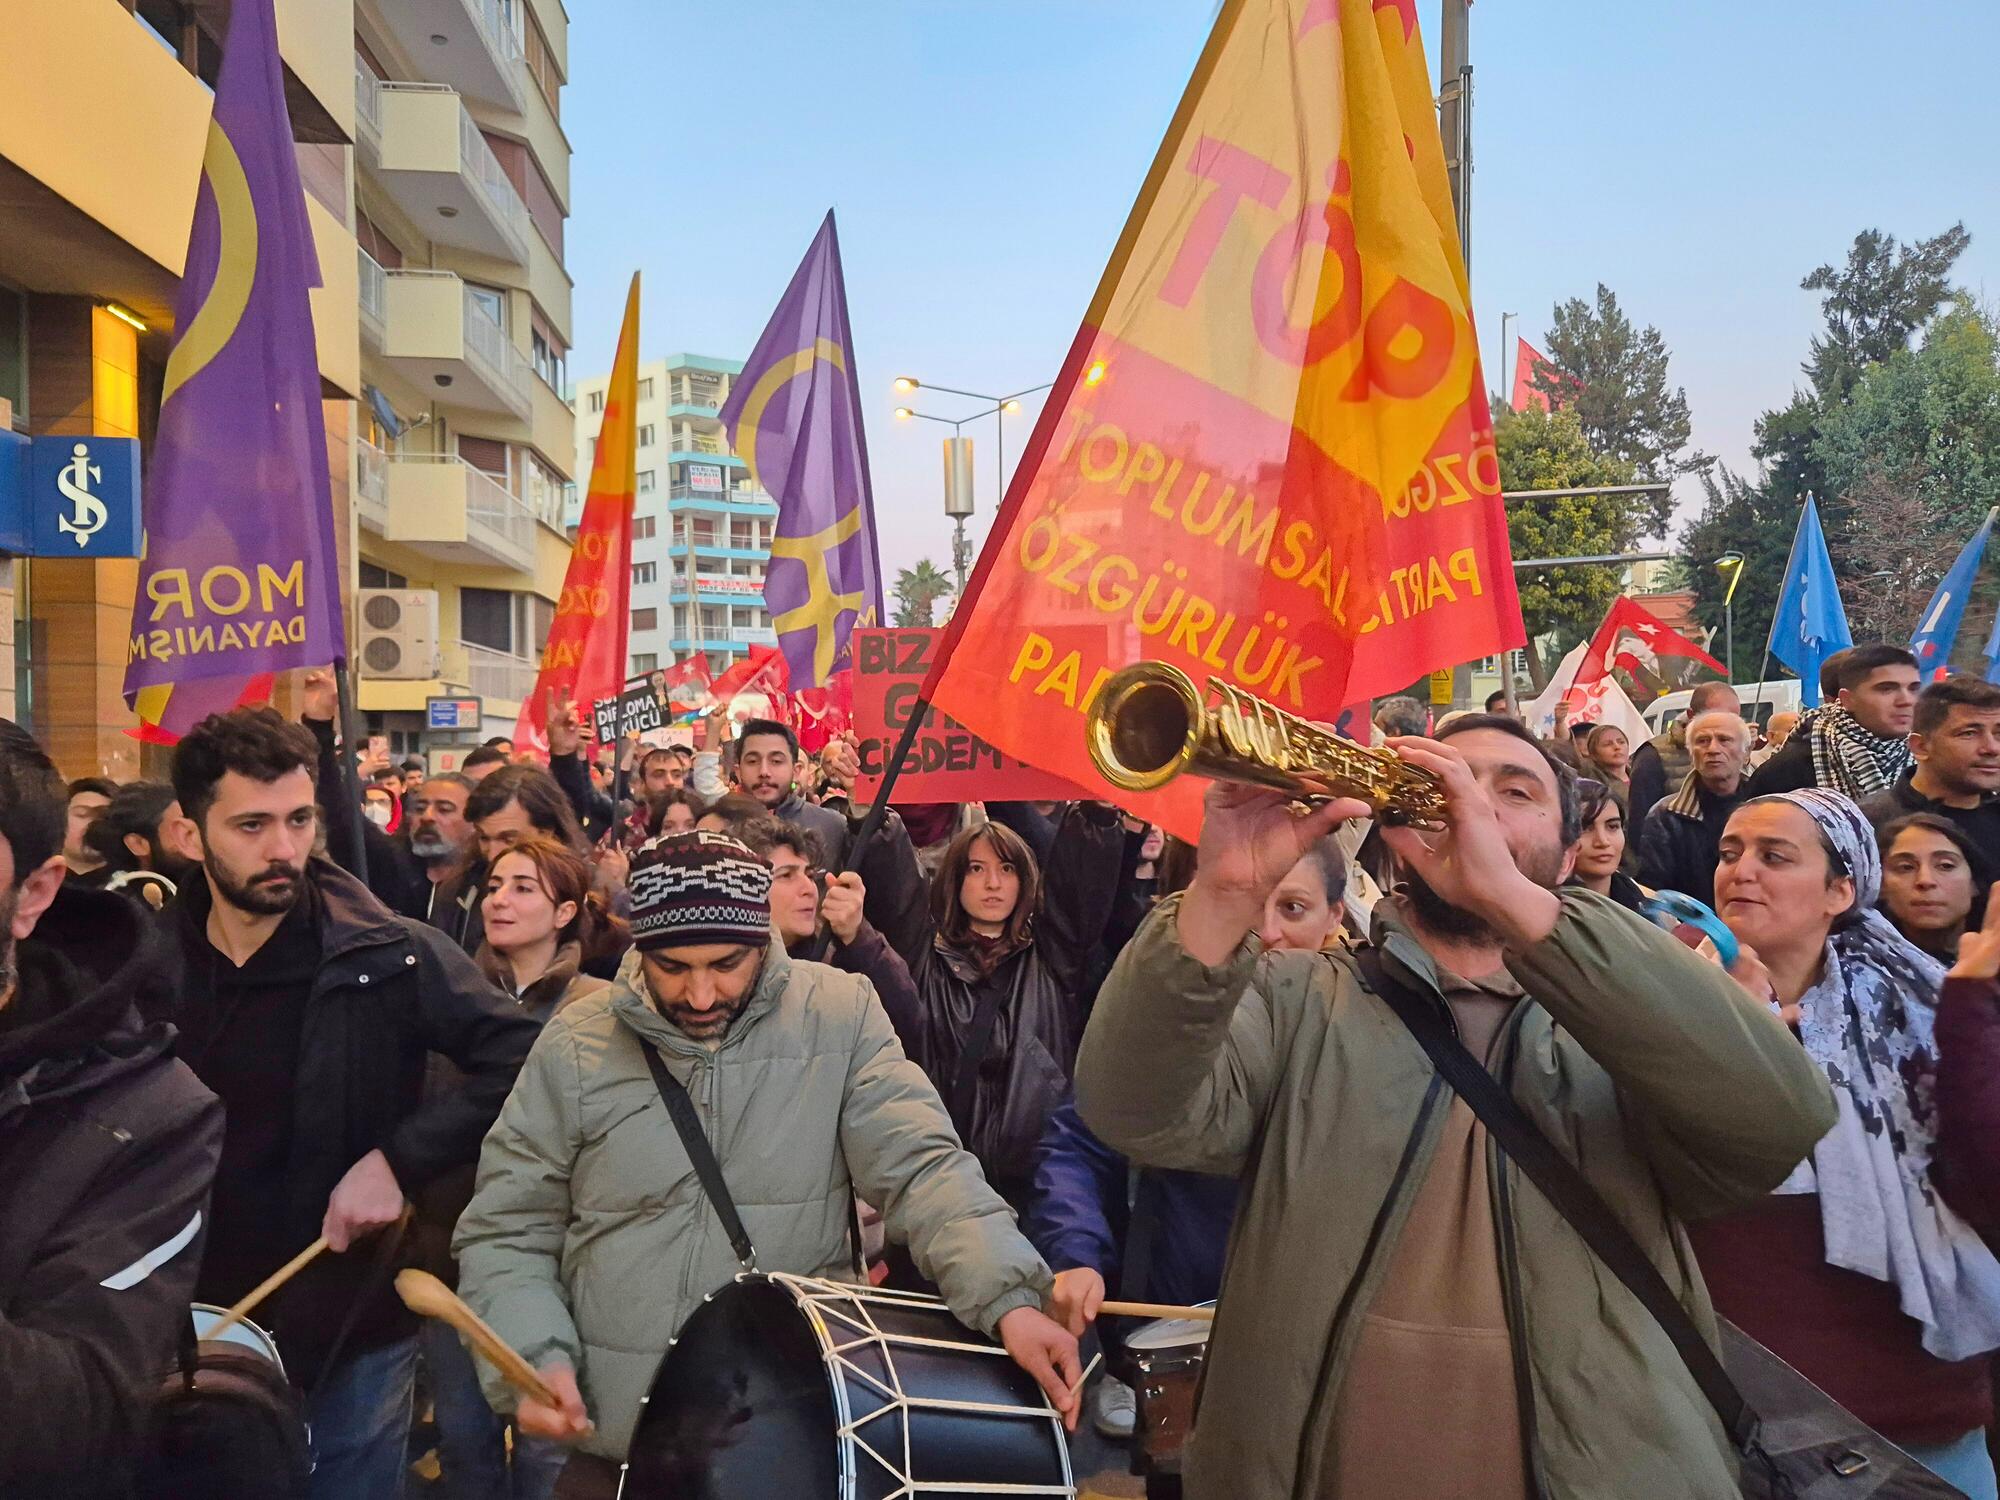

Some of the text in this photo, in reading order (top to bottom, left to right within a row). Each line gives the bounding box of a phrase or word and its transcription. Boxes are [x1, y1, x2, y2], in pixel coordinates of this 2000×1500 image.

[1019, 497, 1324, 707] ÖZGÜRLÜK
[1058, 406, 1346, 627] TOPLUMSAL
[859, 632, 932, 675] BİZ
